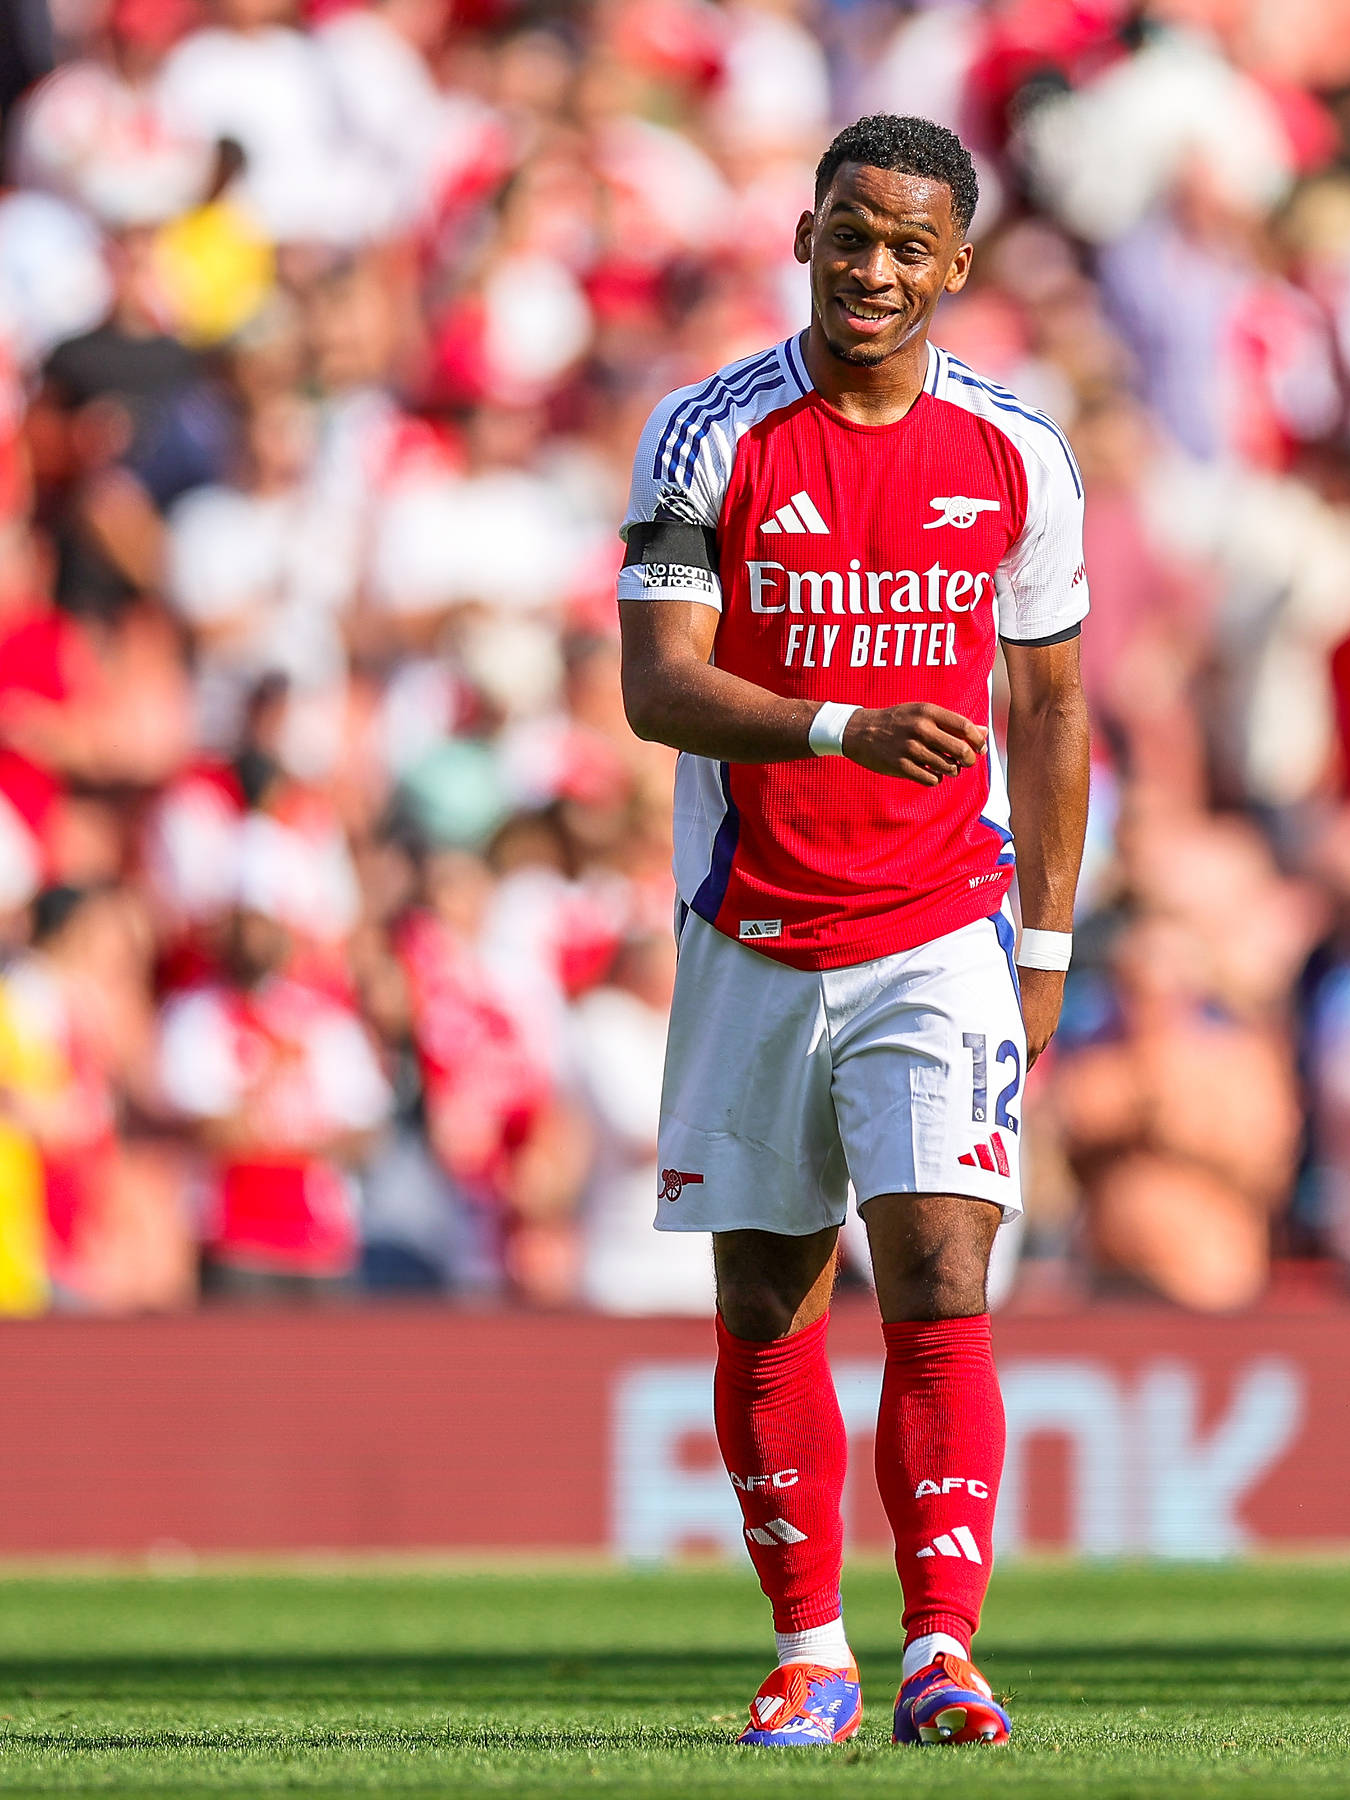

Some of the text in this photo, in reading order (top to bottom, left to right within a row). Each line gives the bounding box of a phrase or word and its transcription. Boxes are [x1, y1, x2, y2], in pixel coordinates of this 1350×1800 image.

[643, 575, 714, 592] for racism
[645, 563, 709, 580] No room
[745, 558, 991, 614] Emirates
[784, 622, 958, 668] FLY BETTER
[962, 1032, 1020, 1136] 12
[730, 1468, 799, 1492] AFC
[915, 1477, 989, 1500] AFC
